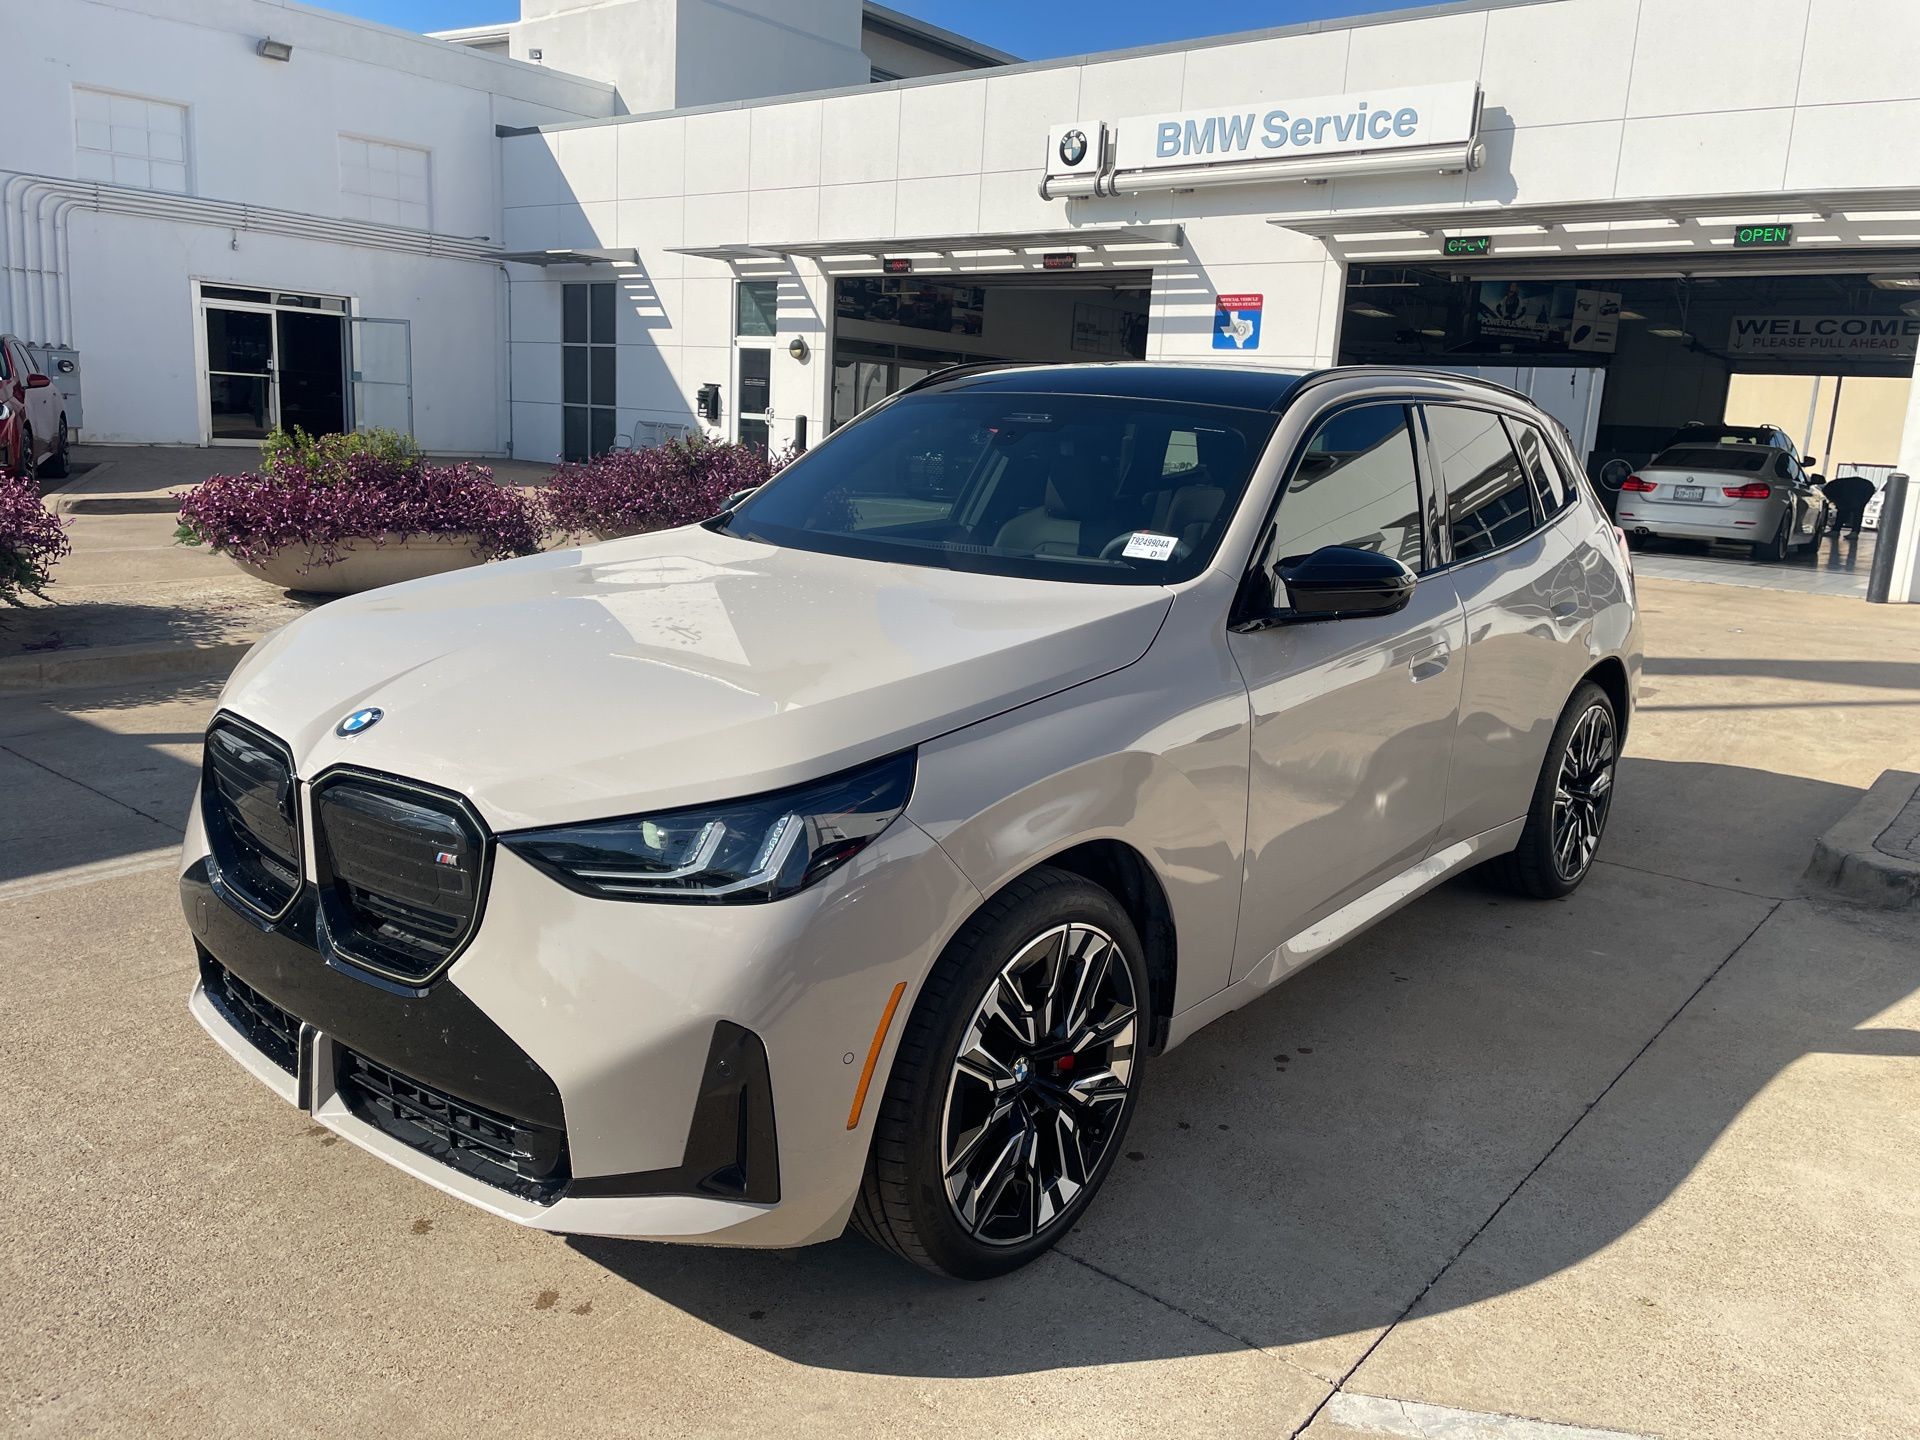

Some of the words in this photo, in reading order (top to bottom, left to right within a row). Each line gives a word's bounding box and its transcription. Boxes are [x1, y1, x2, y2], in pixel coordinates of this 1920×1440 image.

[1157, 114, 1256, 158] BMW
[1261, 102, 1418, 148] Service
[1740, 228, 1787, 242] OPEN
[1736, 319, 1920, 335] WELCOME
[1752, 338, 1806, 348] PLEASE
[1810, 338, 1845, 348] PULL
[1850, 338, 1900, 349] AHEAD
